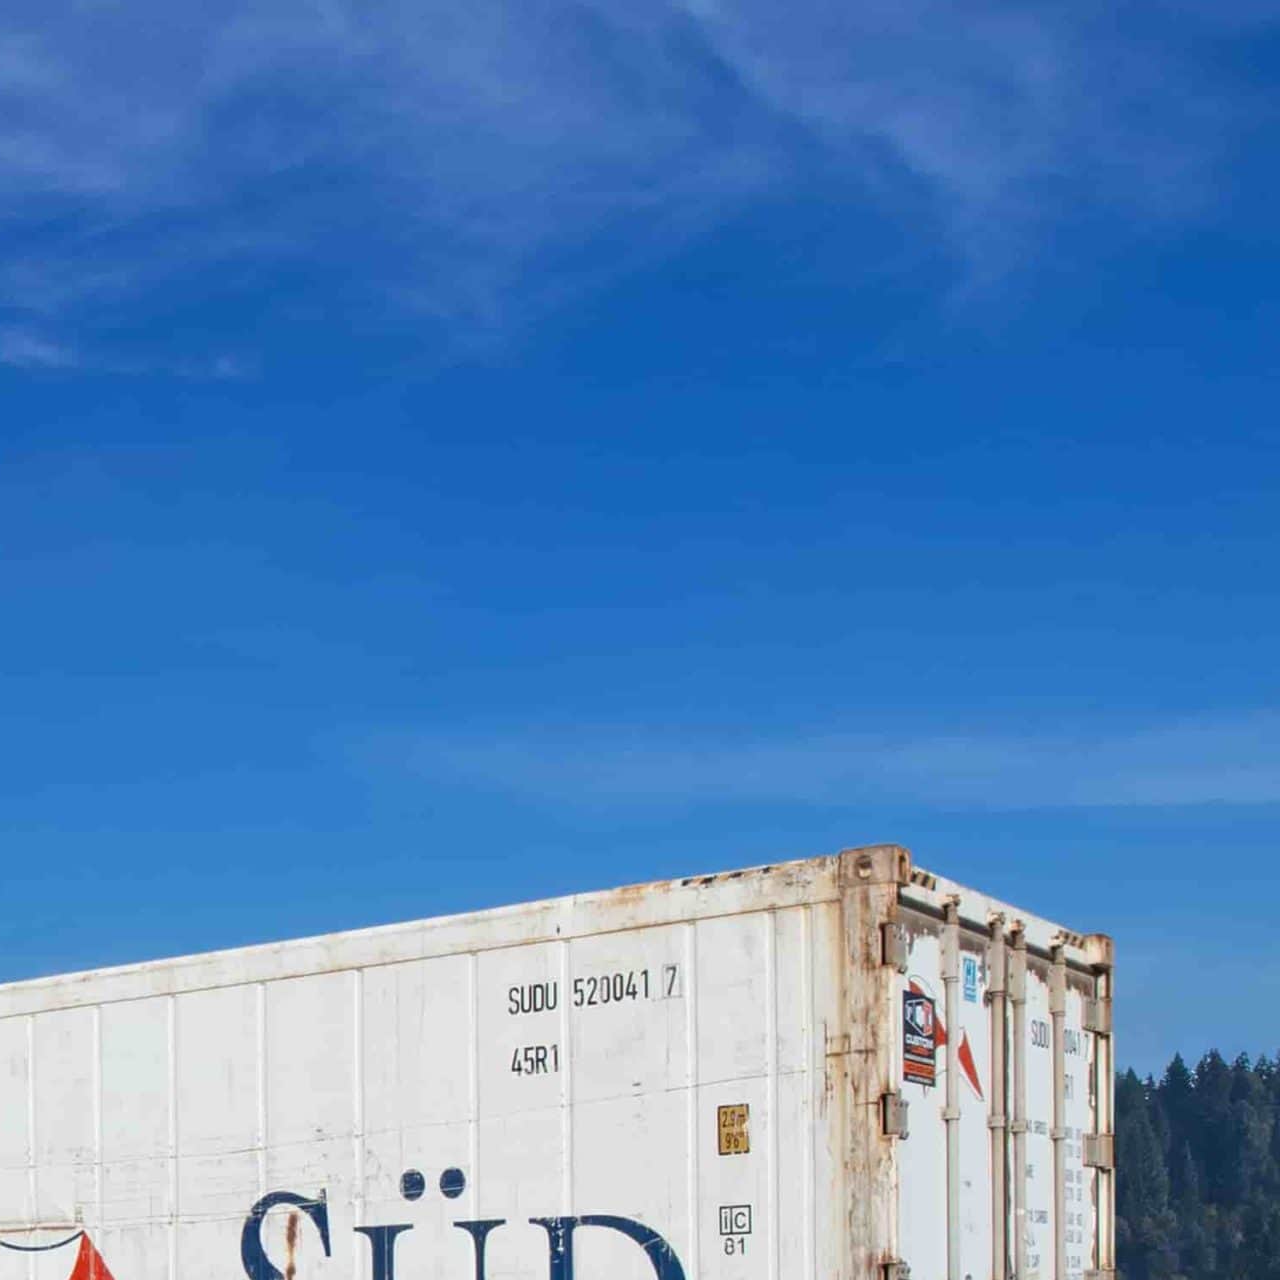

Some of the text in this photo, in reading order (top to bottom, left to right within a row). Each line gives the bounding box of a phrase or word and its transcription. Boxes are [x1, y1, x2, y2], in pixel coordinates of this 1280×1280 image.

[507, 965, 678, 1016] SUDU 520041 7
[511, 1043, 559, 1077] 45R1
